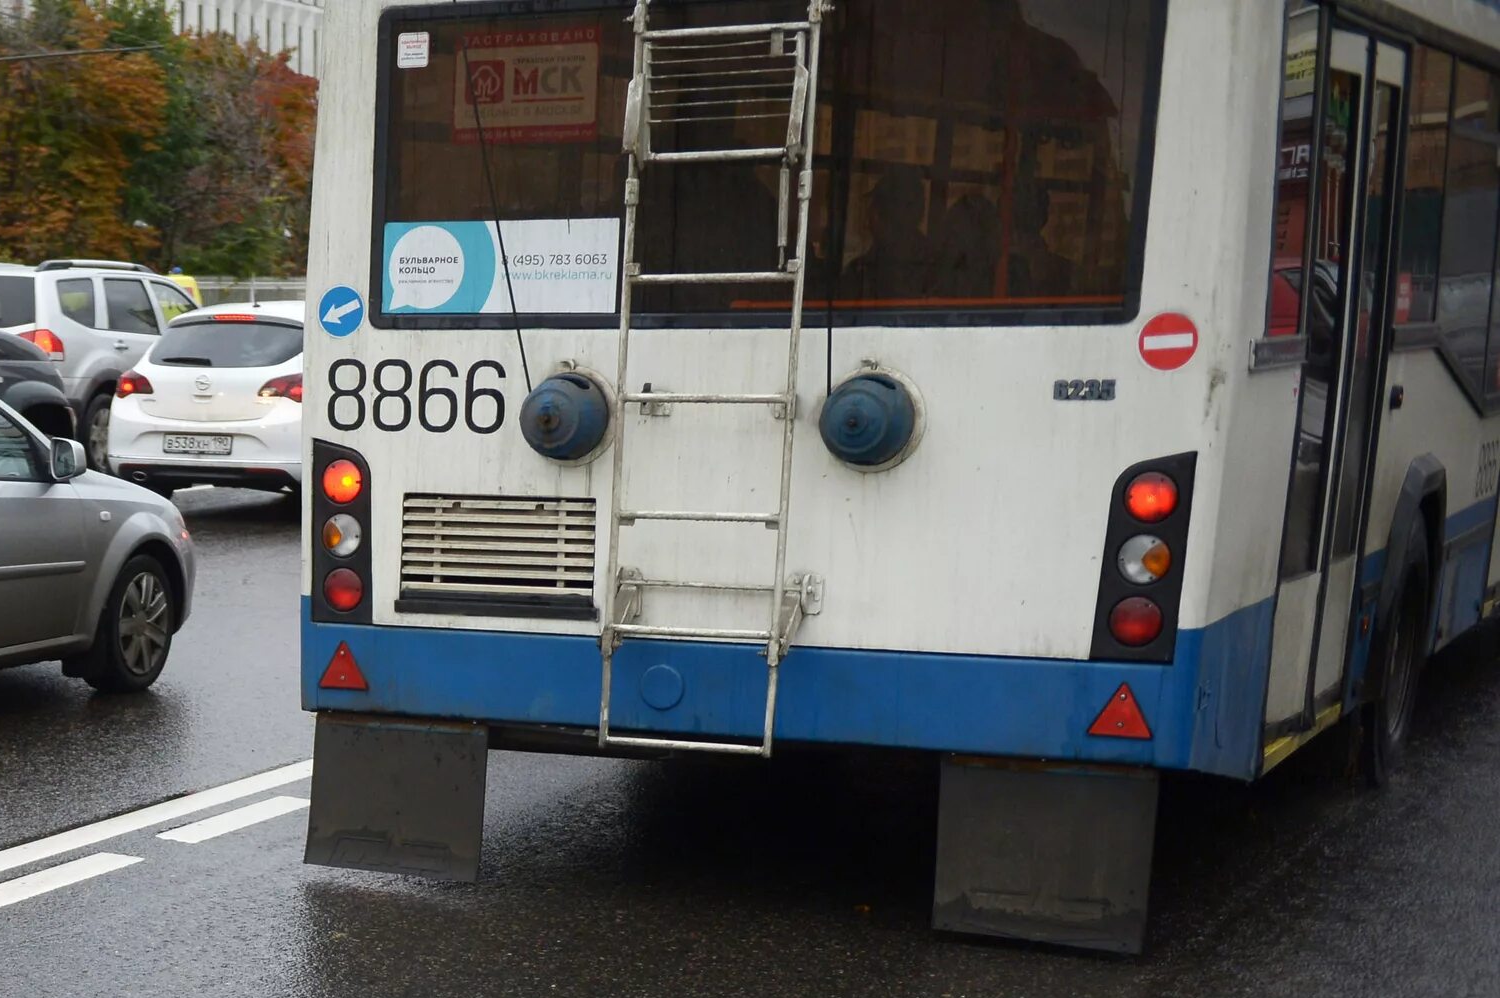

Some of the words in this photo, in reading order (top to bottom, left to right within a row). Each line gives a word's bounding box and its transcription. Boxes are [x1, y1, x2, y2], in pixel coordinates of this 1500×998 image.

[513, 65, 583, 95] МСК
[399, 256, 459, 265] БУЛЬВАРНОЕ
[512, 254, 545, 267] (495)
[549, 254, 571, 265] 783
[574, 253, 607, 265] 6063
[398, 266, 436, 275] КОЛЬЦО
[501, 269, 612, 281] www.bkreklama.ru
[328, 358, 506, 434] 8866
[1053, 379, 1116, 400] 6235
